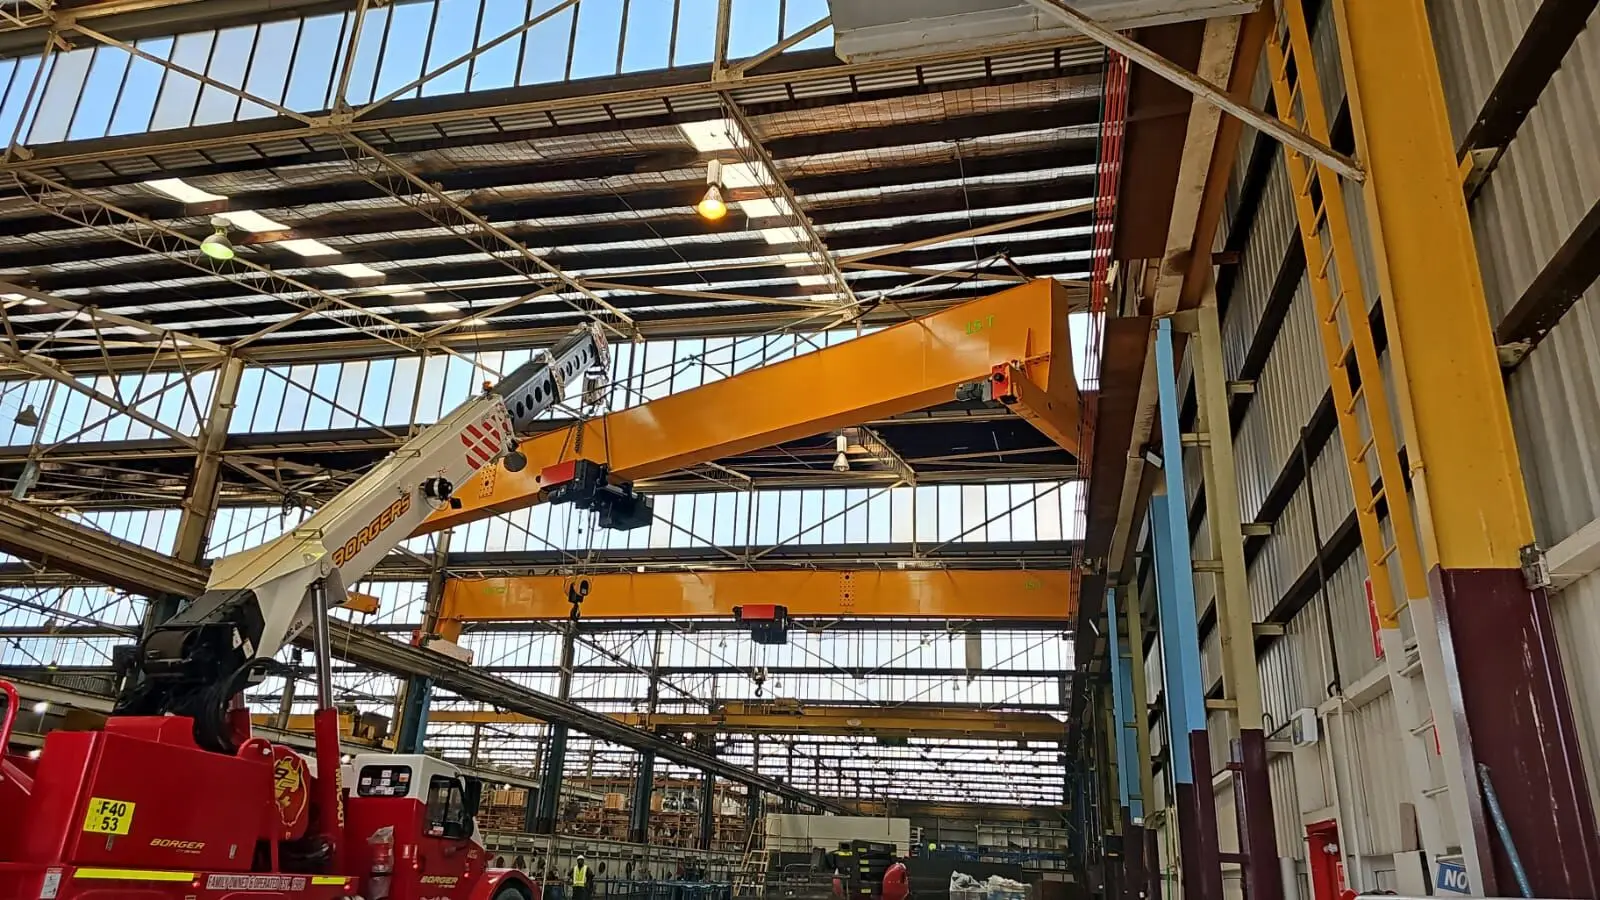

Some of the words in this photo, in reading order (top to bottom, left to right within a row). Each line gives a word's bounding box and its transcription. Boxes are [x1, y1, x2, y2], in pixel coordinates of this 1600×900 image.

[966, 320, 982, 336] 15
[986, 314, 995, 328] T
[332, 494, 411, 568] BORGERS
[100, 801, 127, 817] F40
[101, 816, 119, 831] 53
[150, 838, 205, 850] BORGER
